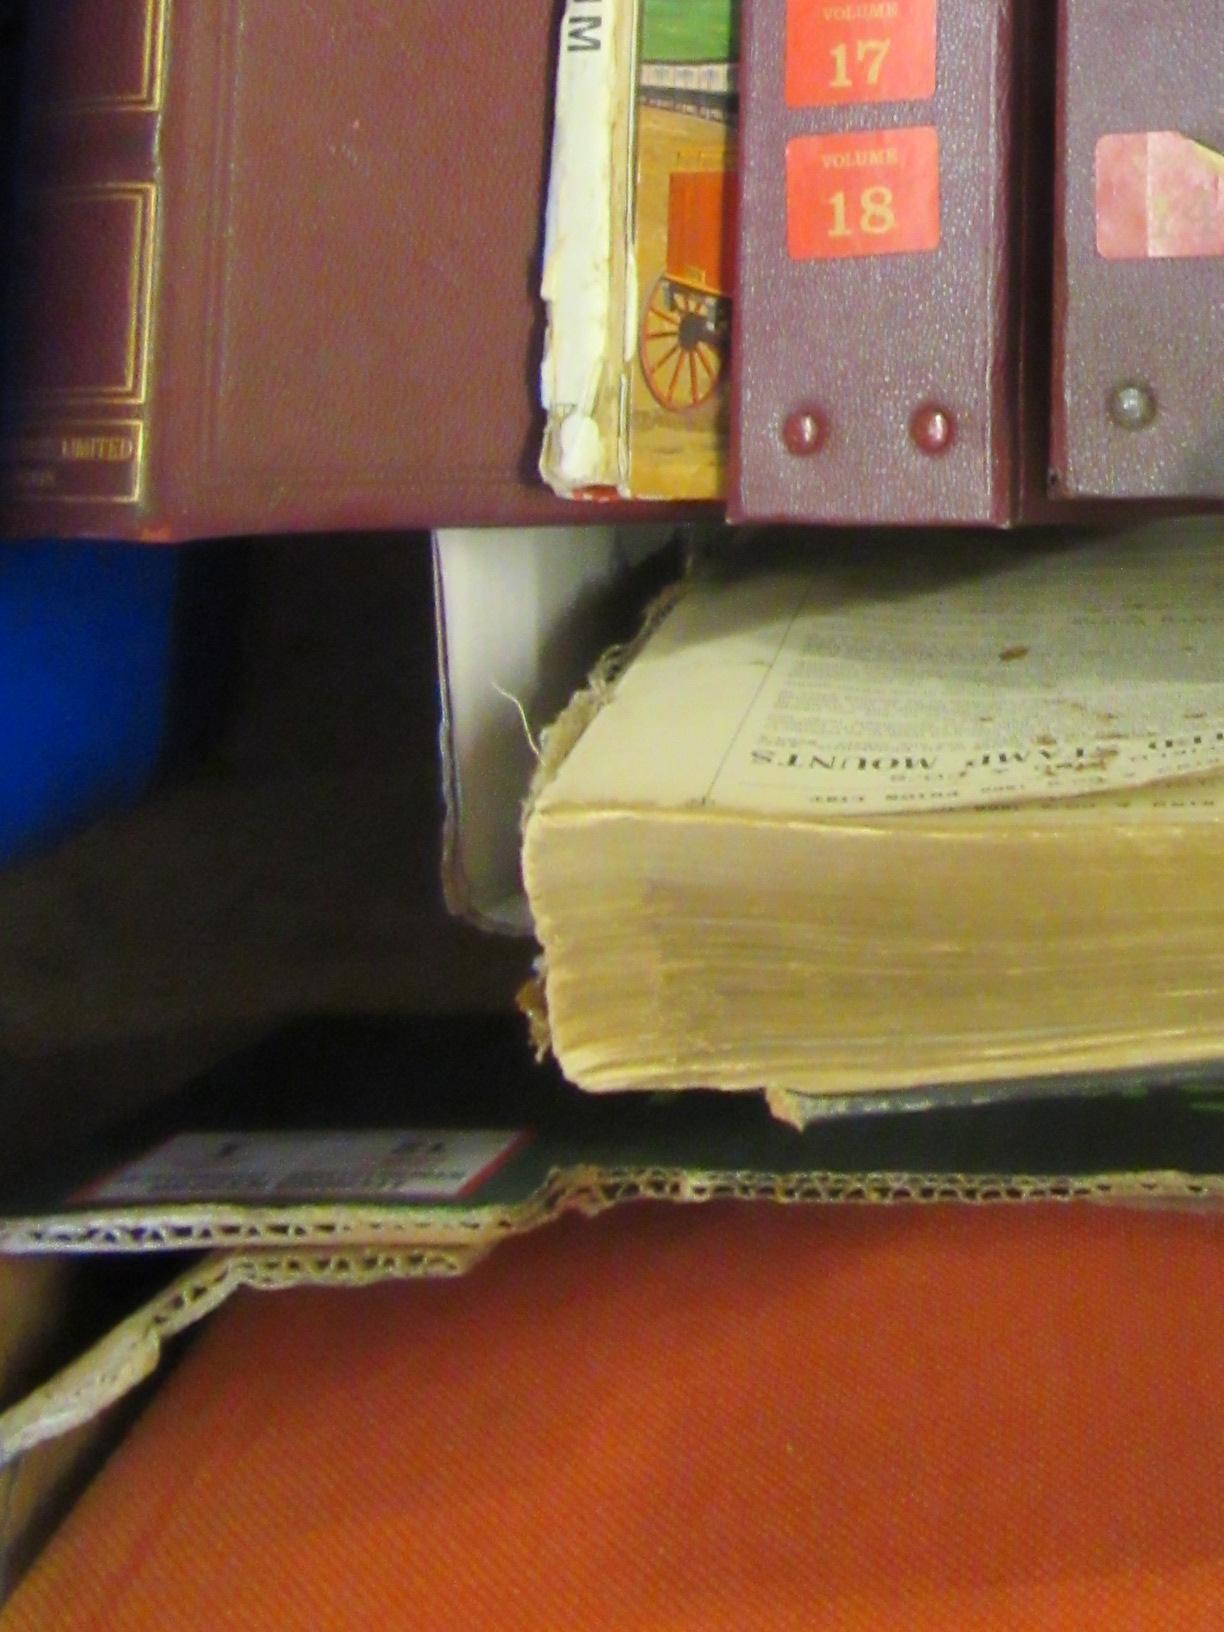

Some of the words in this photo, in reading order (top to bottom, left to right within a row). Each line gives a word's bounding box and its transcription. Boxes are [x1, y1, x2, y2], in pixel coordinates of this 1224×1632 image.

[821, 3, 898, 21] VOLUME
[828, 38, 892, 88] 17
[821, 149, 898, 169] VOLUME
[826, 185, 896, 237] 18
